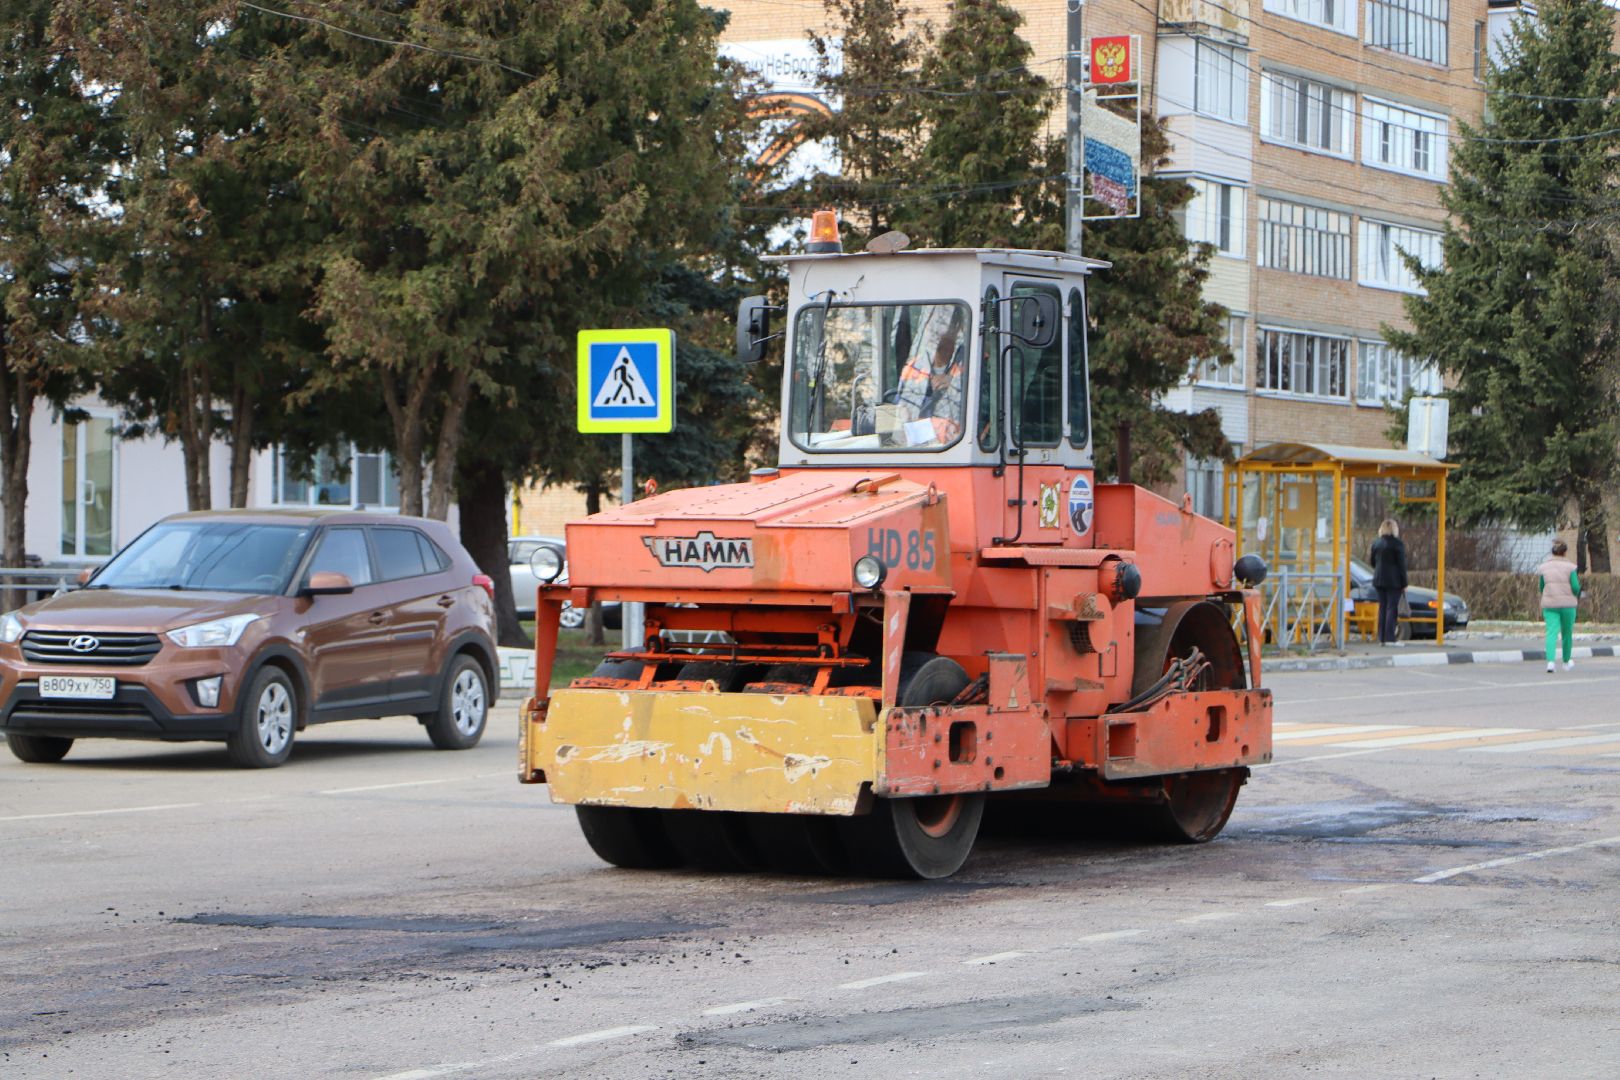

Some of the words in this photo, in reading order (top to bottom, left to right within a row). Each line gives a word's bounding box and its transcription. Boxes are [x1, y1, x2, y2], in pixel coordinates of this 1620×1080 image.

[665, 540, 751, 563] HAMM
[867, 527, 902, 569] HD
[906, 529, 936, 571] 85
[91, 678, 112, 690] 750
